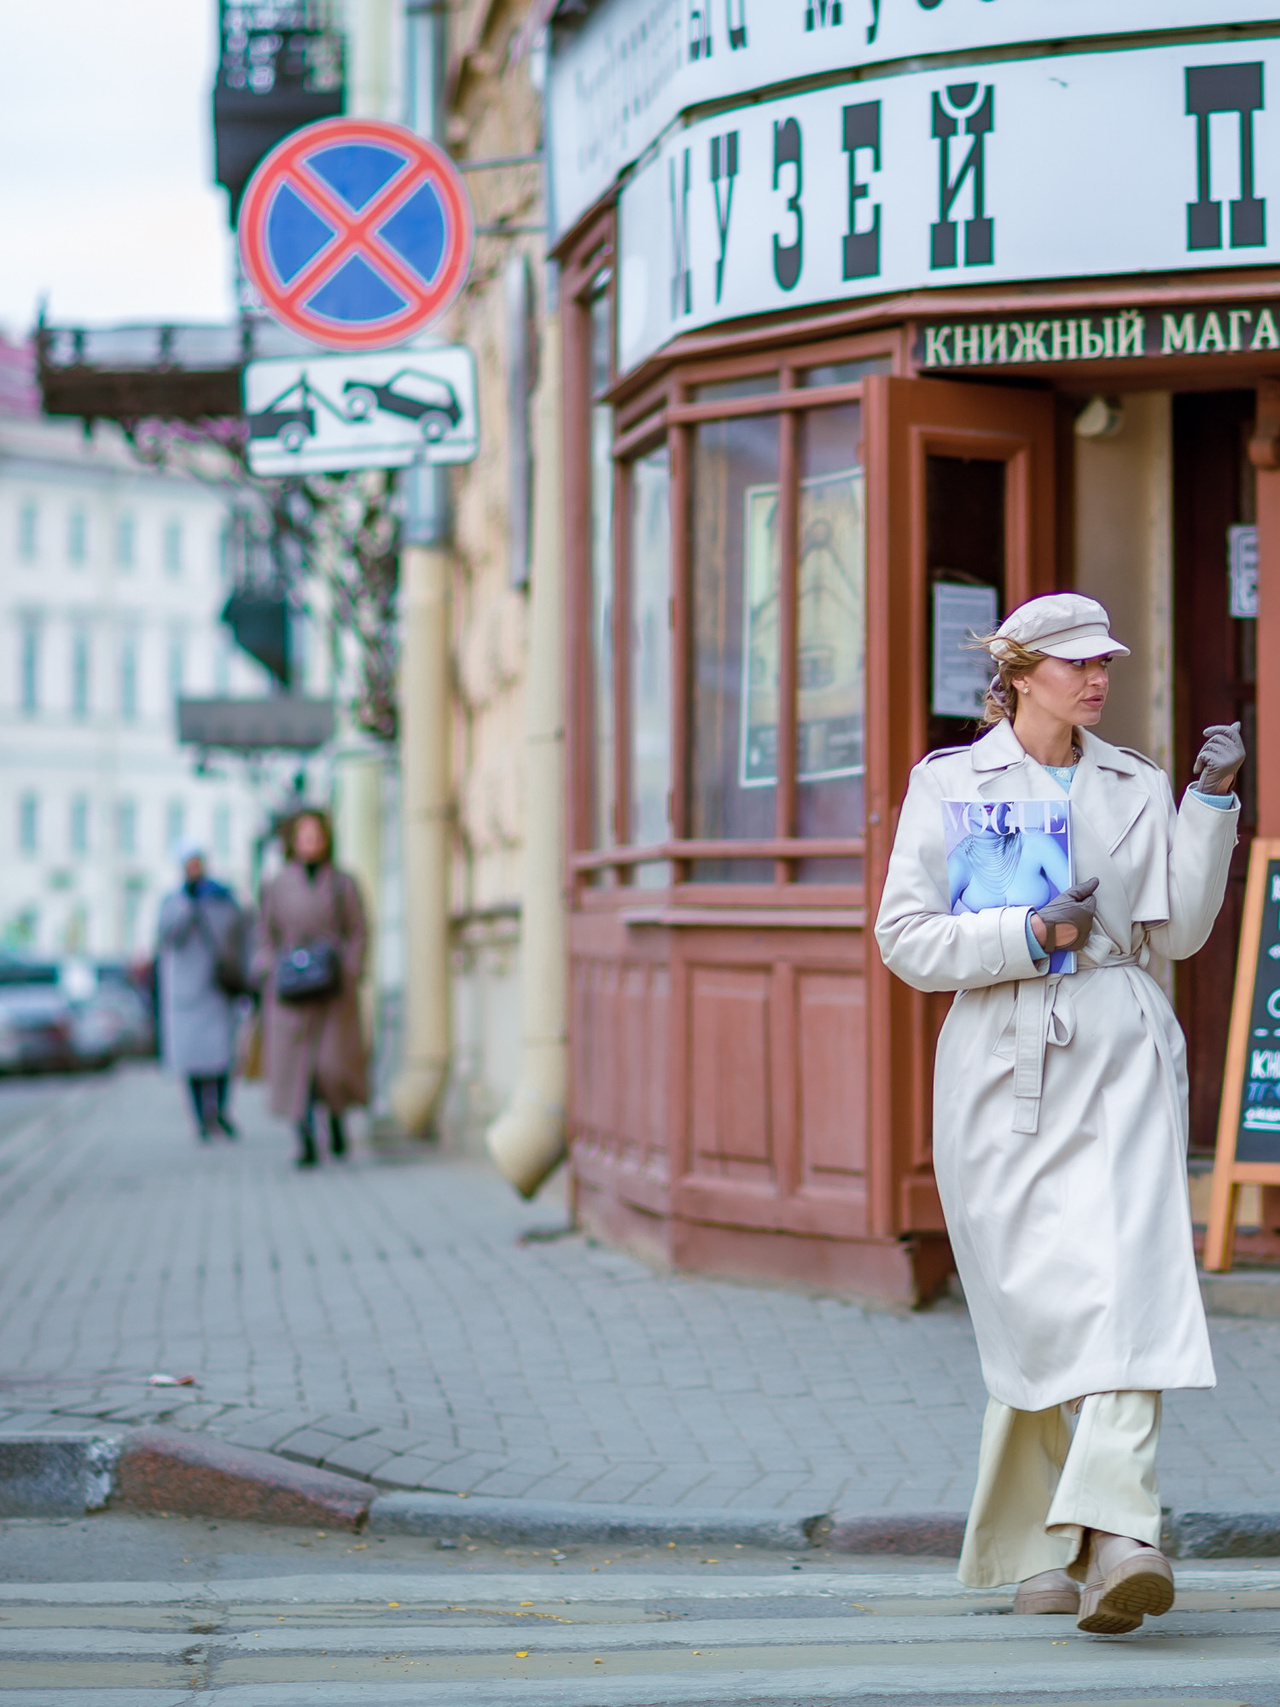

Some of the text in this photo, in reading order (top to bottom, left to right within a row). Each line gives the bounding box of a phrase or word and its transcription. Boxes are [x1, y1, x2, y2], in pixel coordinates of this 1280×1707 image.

[670, 82, 995, 320] МУЗЕЙ
[924, 308, 1146, 368] КНИЖНЫЙ
[943, 801, 1067, 836] VOGUE
